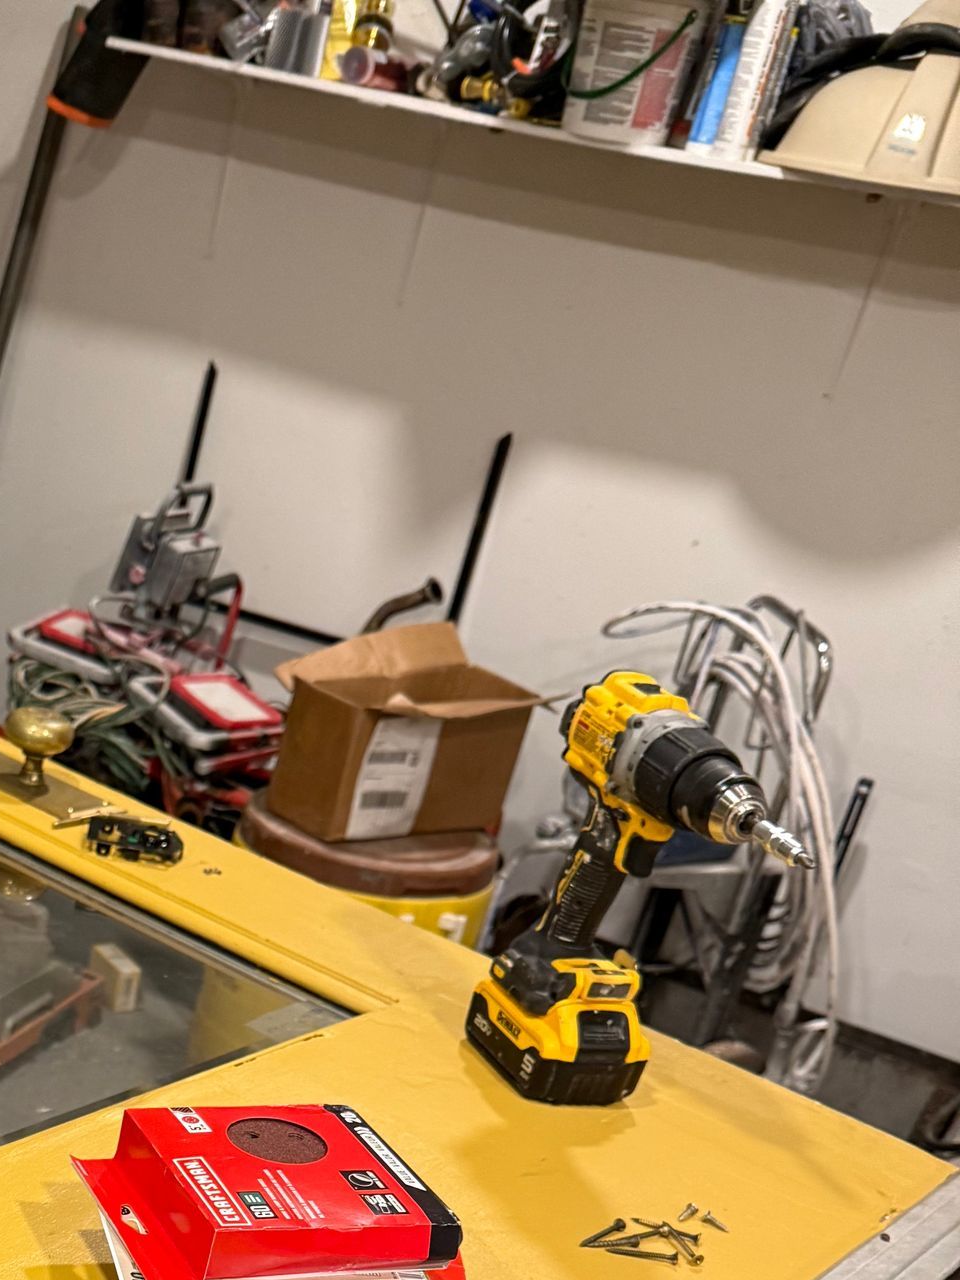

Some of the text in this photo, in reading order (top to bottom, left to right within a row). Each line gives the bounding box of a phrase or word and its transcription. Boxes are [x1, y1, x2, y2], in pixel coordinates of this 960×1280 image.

[521, 1053, 535, 1073] 5
[340, 1110, 362, 1123] 20
[183, 1160, 240, 1222] CRAFTSMAN
[249, 1205, 275, 1218] 60
